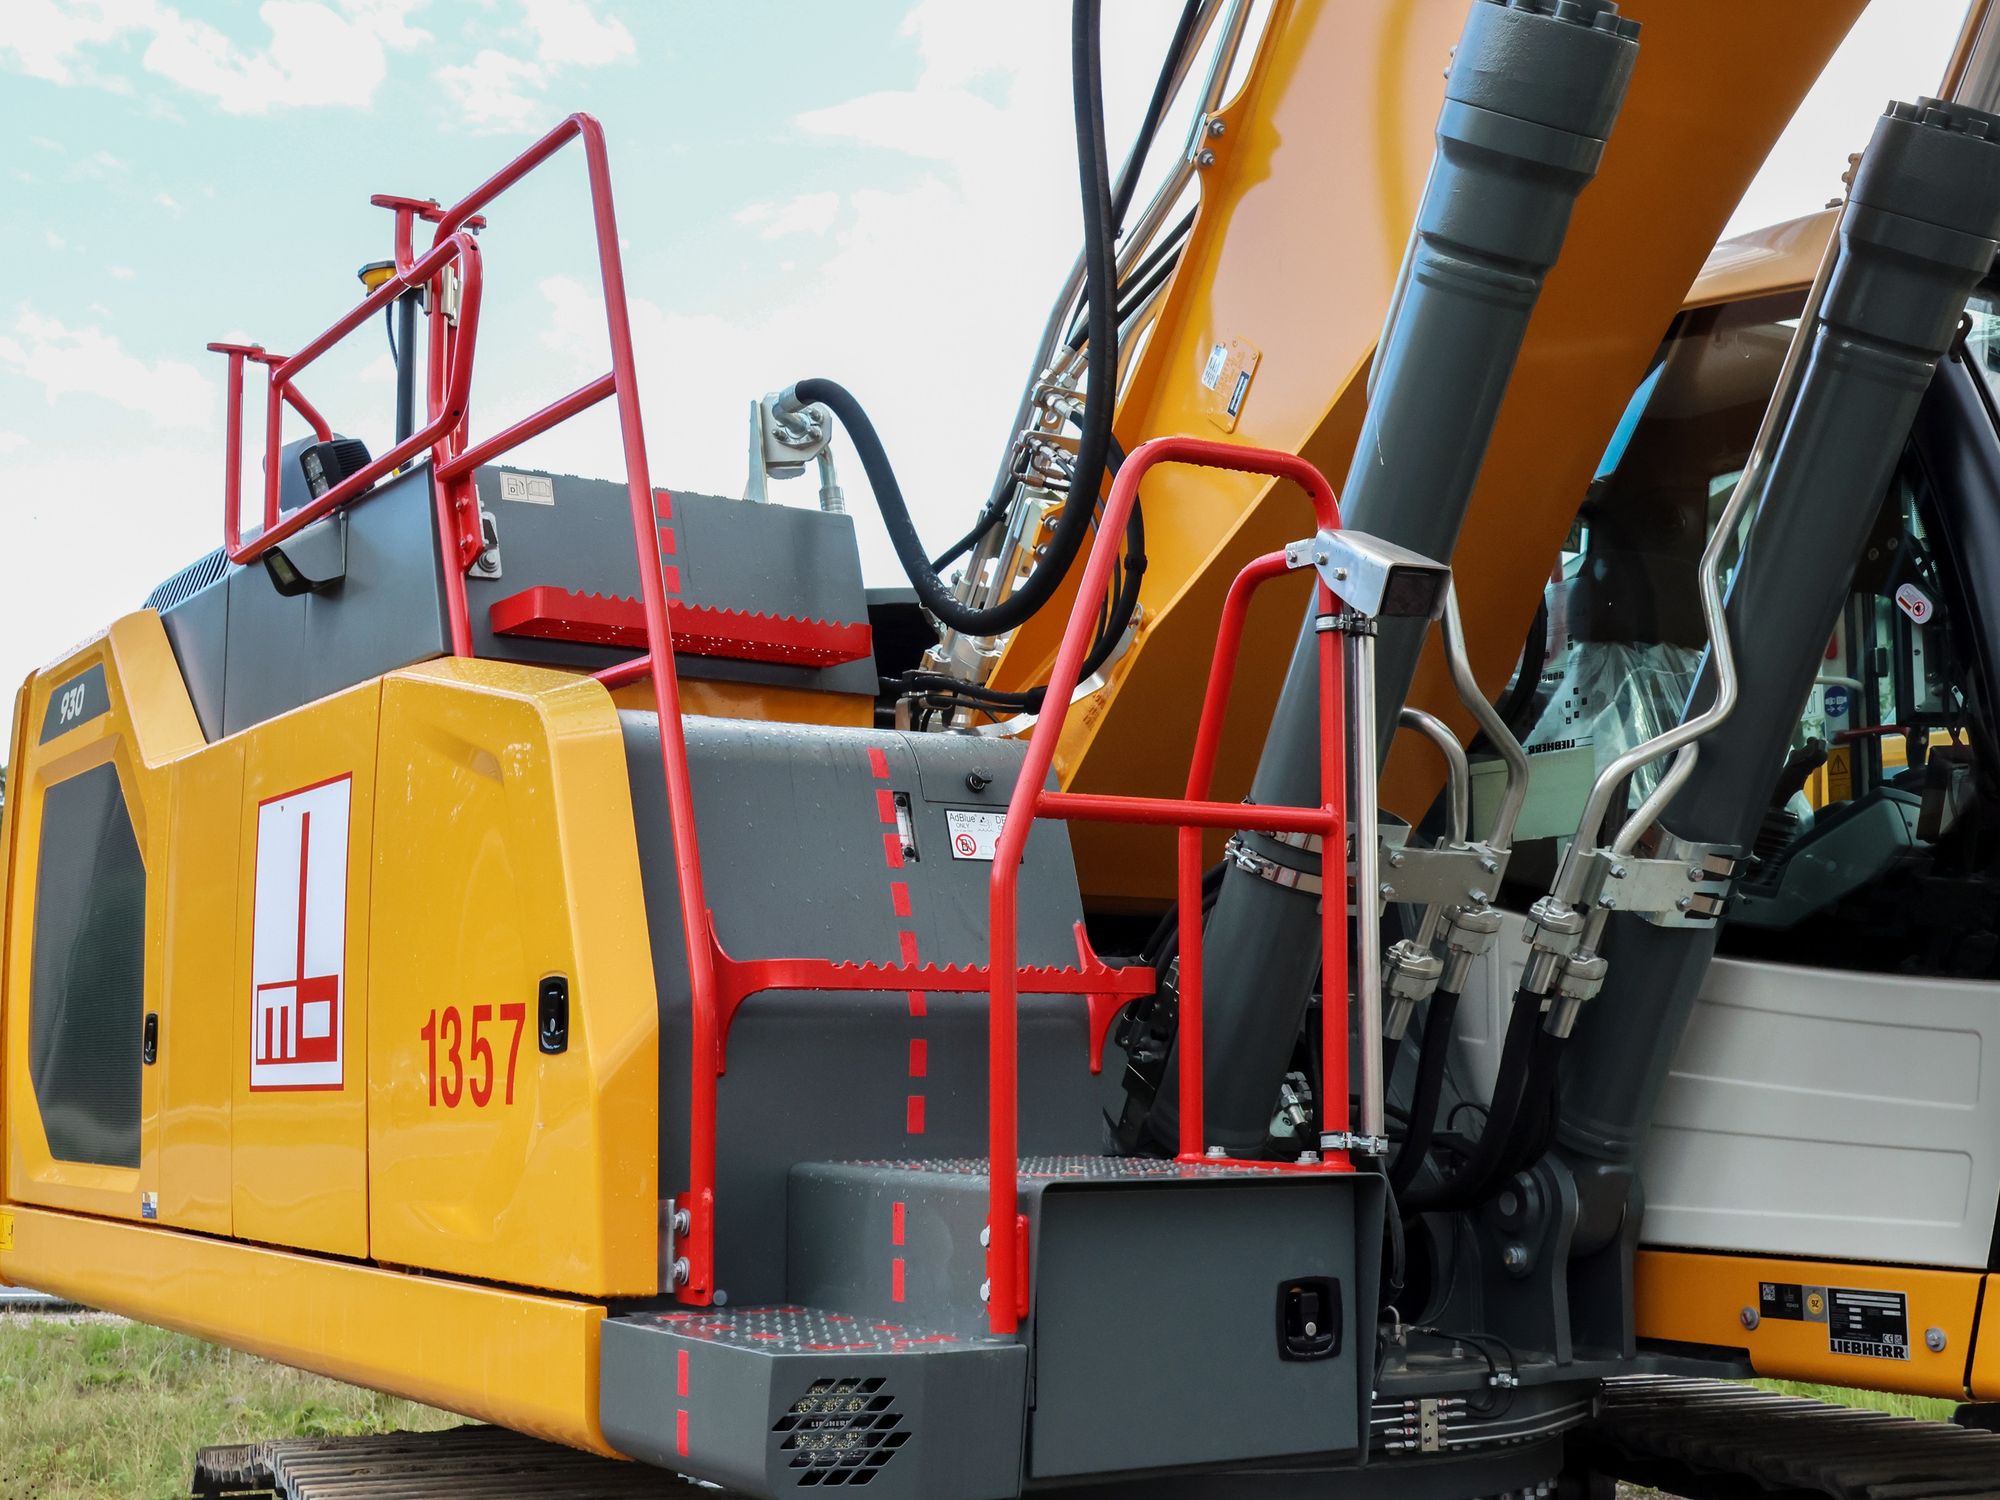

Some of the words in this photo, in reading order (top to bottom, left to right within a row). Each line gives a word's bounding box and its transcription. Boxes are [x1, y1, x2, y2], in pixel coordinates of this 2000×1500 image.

[60, 683, 85, 724] 930
[420, 1002, 526, 1108] 1357
[1830, 1339, 1906, 1359] LIEBHERR
